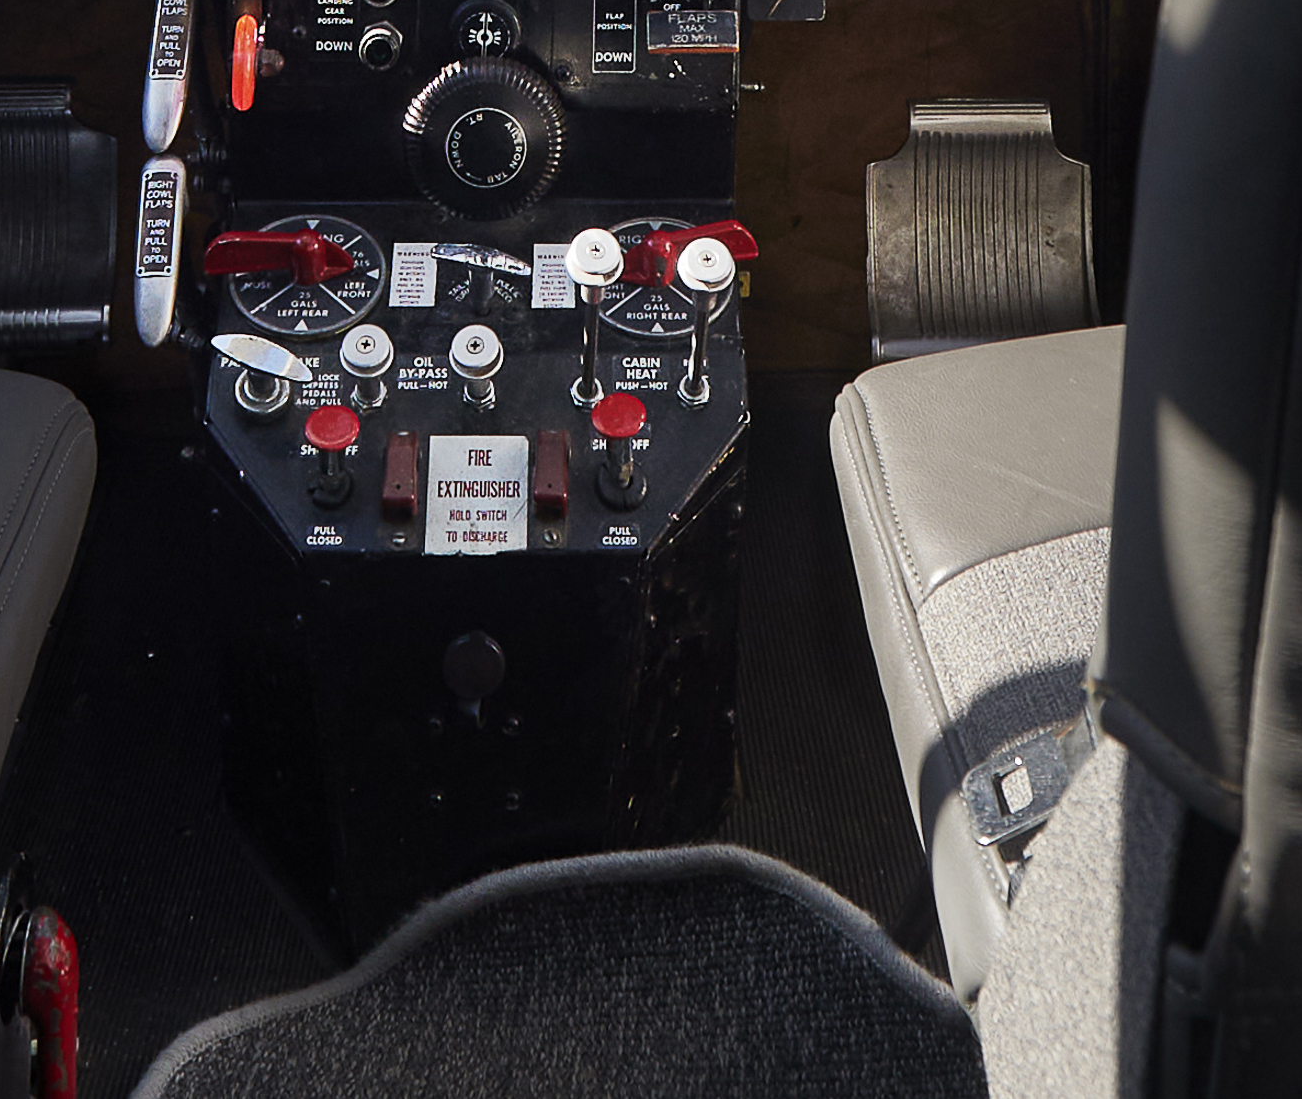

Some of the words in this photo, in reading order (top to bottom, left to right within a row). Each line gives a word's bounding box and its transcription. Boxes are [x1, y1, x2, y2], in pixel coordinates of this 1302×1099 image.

[162, 7, 188, 15] FLAPS
[668, 14, 717, 23] FLAPS
[160, 42, 180, 50] PULL
[316, 41, 353, 50] DOWN
[595, 52, 632, 62] DOWN
[157, 59, 181, 67] OPEN
[451, 131, 464, 168] DOWN
[505, 122, 523, 169] AILERON
[148, 181, 174, 189] RIGHT
[147, 190, 173, 199] COWL
[145, 200, 173, 209] FLAPS
[146, 219, 170, 228] TURN
[145, 237, 167, 245] PULL
[143, 255, 168, 264] OPEN
[414, 357, 433, 368] OIL
[622, 358, 660, 367] CABIN
[399, 369, 448, 379] BY-PASS
[627, 369, 657, 379] HEAT
[468, 450, 492, 466] FIRE
[437, 481, 520, 498] EXTINGUISHER
[450, 510, 471, 521] HOLD
[476, 510, 507, 521] SWITCH
[313, 526, 336, 535] PULL
[609, 527, 631, 535] PULL
[306, 536, 342, 545] CLOSED
[446, 531, 457, 542] TO
[463, 531, 508, 543] DISCHARGE
[602, 536, 637, 545] CLOSED
